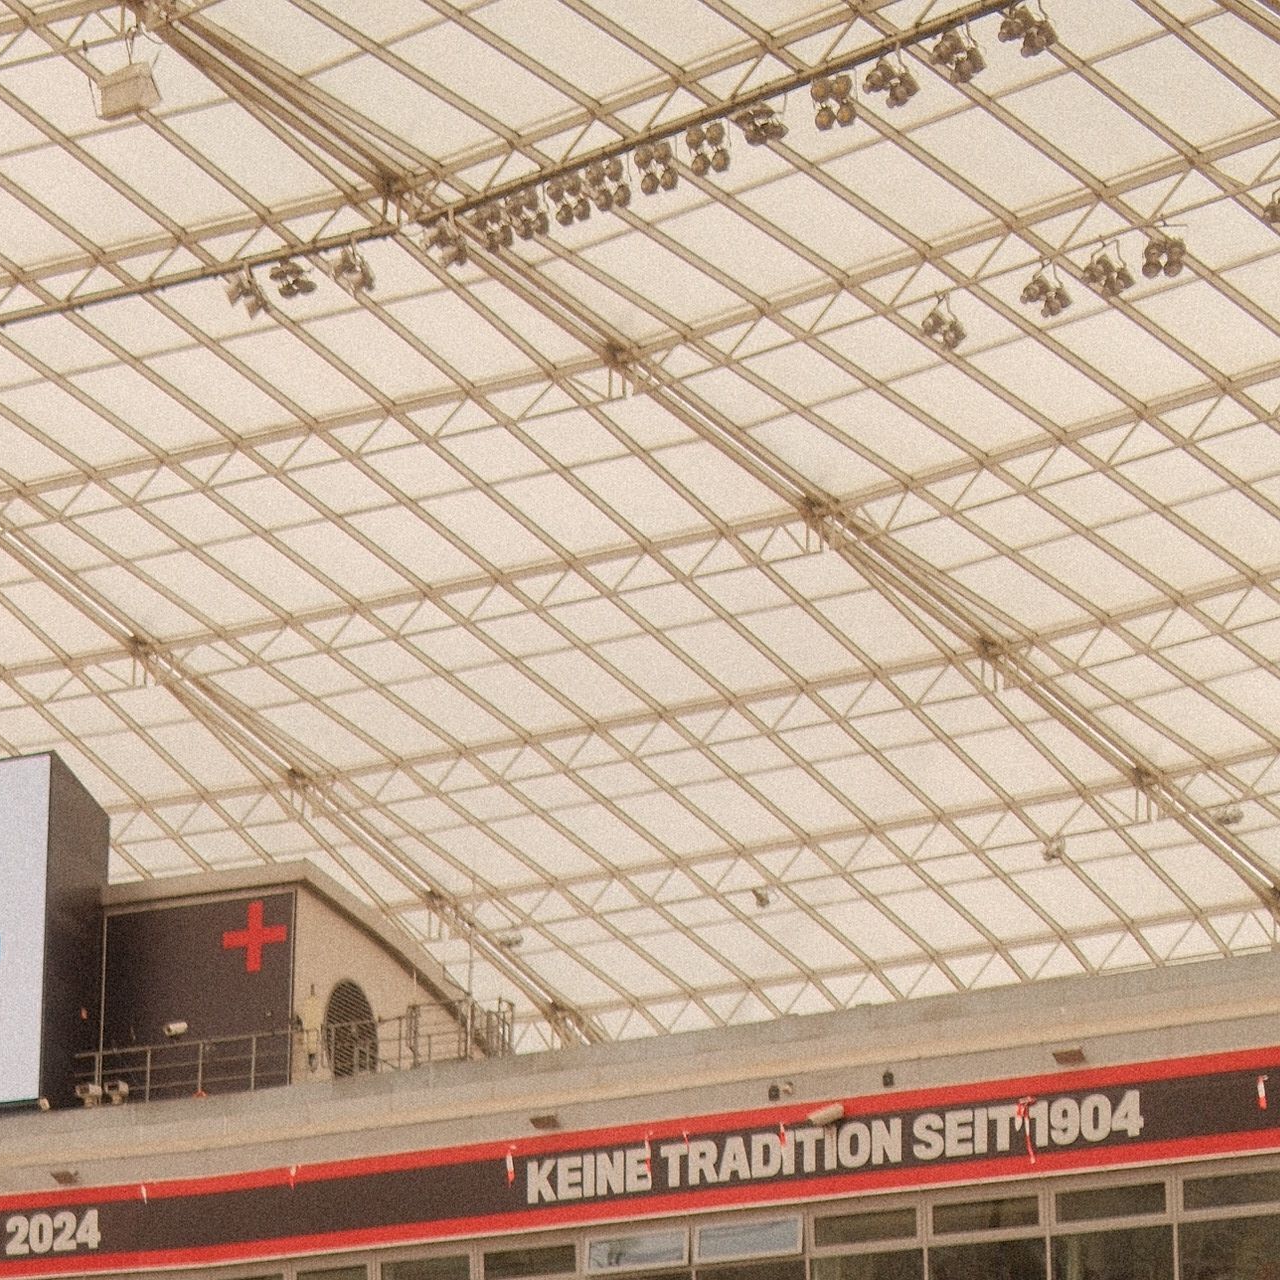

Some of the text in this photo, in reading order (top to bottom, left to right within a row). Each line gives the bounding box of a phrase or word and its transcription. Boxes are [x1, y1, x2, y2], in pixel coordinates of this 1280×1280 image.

[526, 1088, 1145, 1205] KEINE TRADITION SEIT 1904
[5, 1209, 102, 1257] 2024
